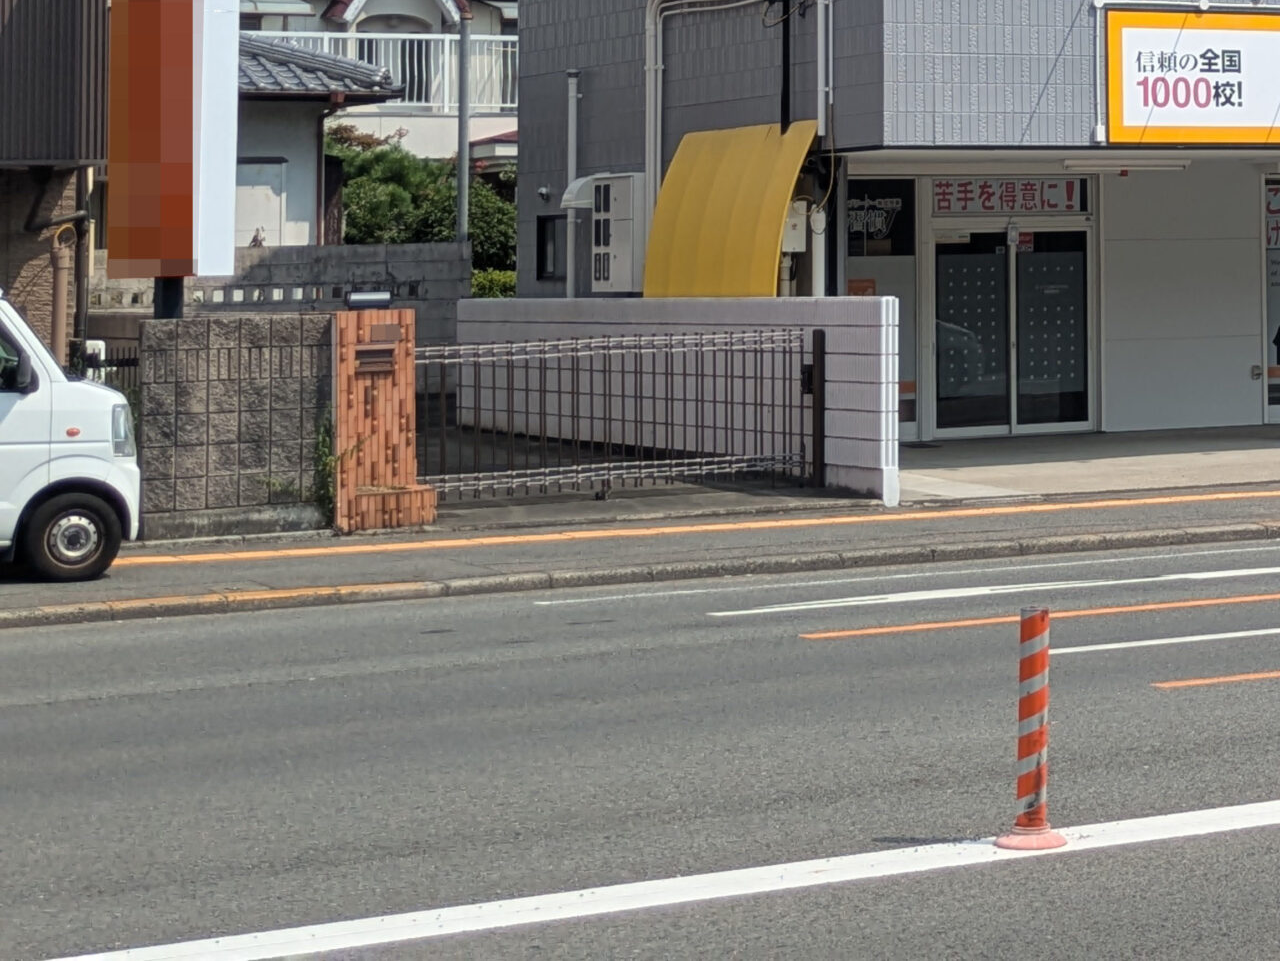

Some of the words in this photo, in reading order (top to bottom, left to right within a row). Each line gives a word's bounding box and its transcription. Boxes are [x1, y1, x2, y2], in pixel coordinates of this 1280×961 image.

[1135, 48, 1242, 75] 信頼の全国
